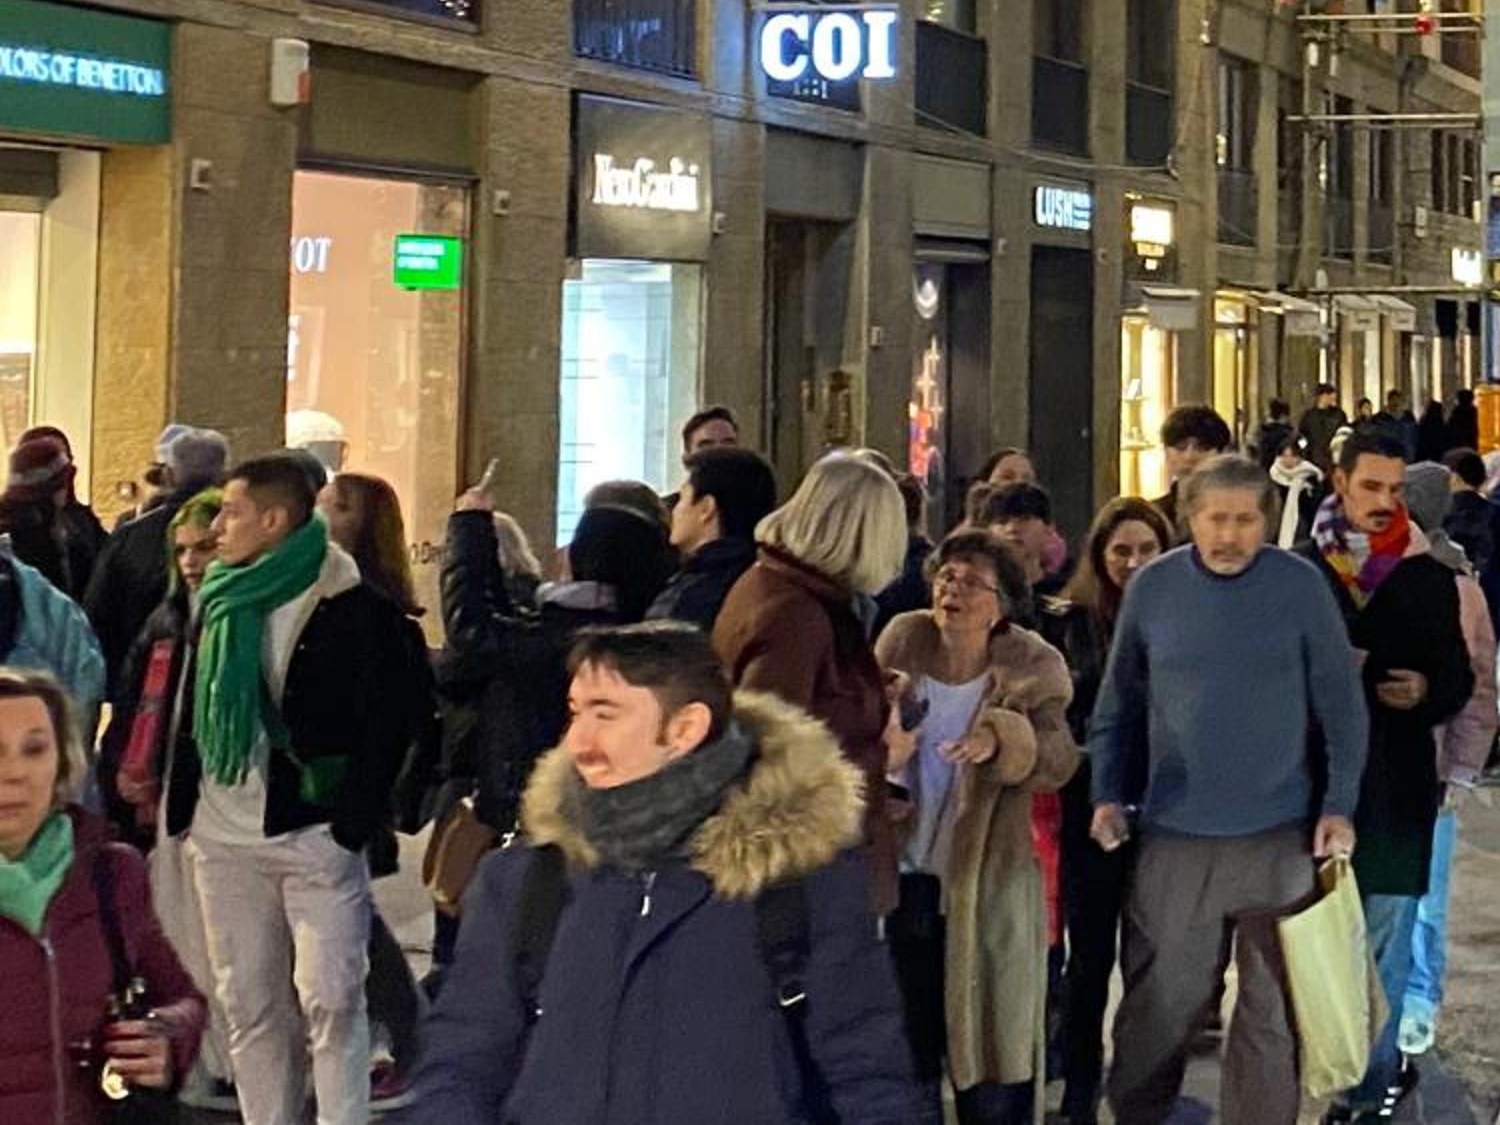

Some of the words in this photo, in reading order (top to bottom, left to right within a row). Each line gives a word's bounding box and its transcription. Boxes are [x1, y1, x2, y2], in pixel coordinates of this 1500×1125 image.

[760, 12, 897, 81] COI
[51, 54, 76, 84] OF
[76, 58, 165, 96] BENETTON
[1036, 186, 1073, 228] LUSH
